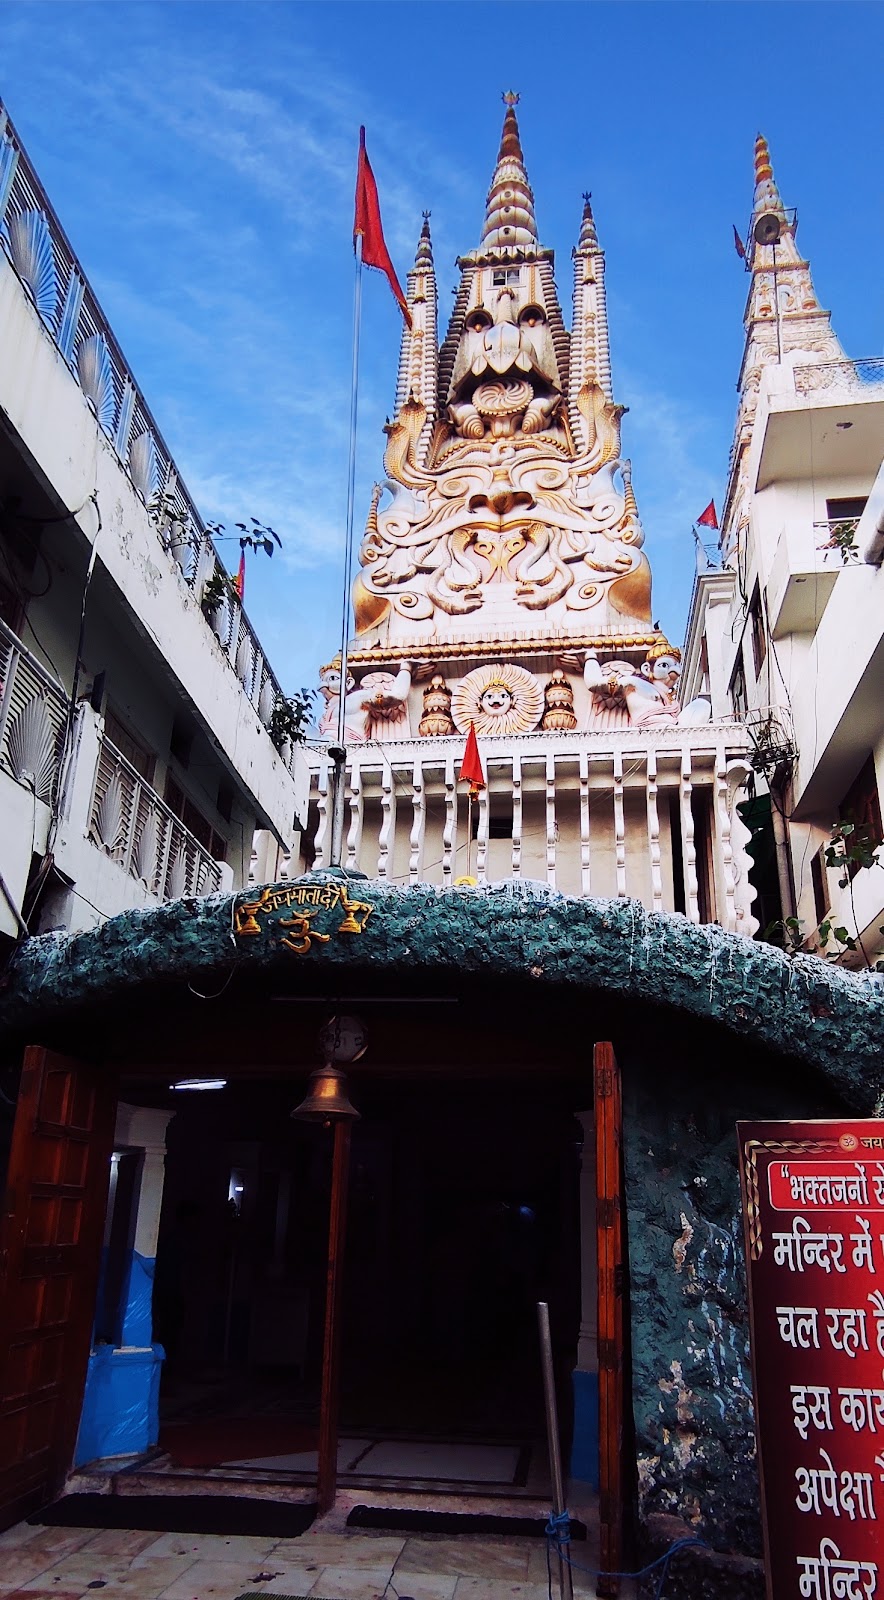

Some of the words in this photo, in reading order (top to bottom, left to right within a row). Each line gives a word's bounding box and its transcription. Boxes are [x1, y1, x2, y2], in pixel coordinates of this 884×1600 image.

[772, 1215, 847, 1273] मन्दिर
[849, 1214, 876, 1273] में
[775, 1306, 821, 1349] चल
[824, 1308, 869, 1358] रहा
[790, 1385, 834, 1440] इस
[794, 1447, 877, 1520] अपेक्षा
